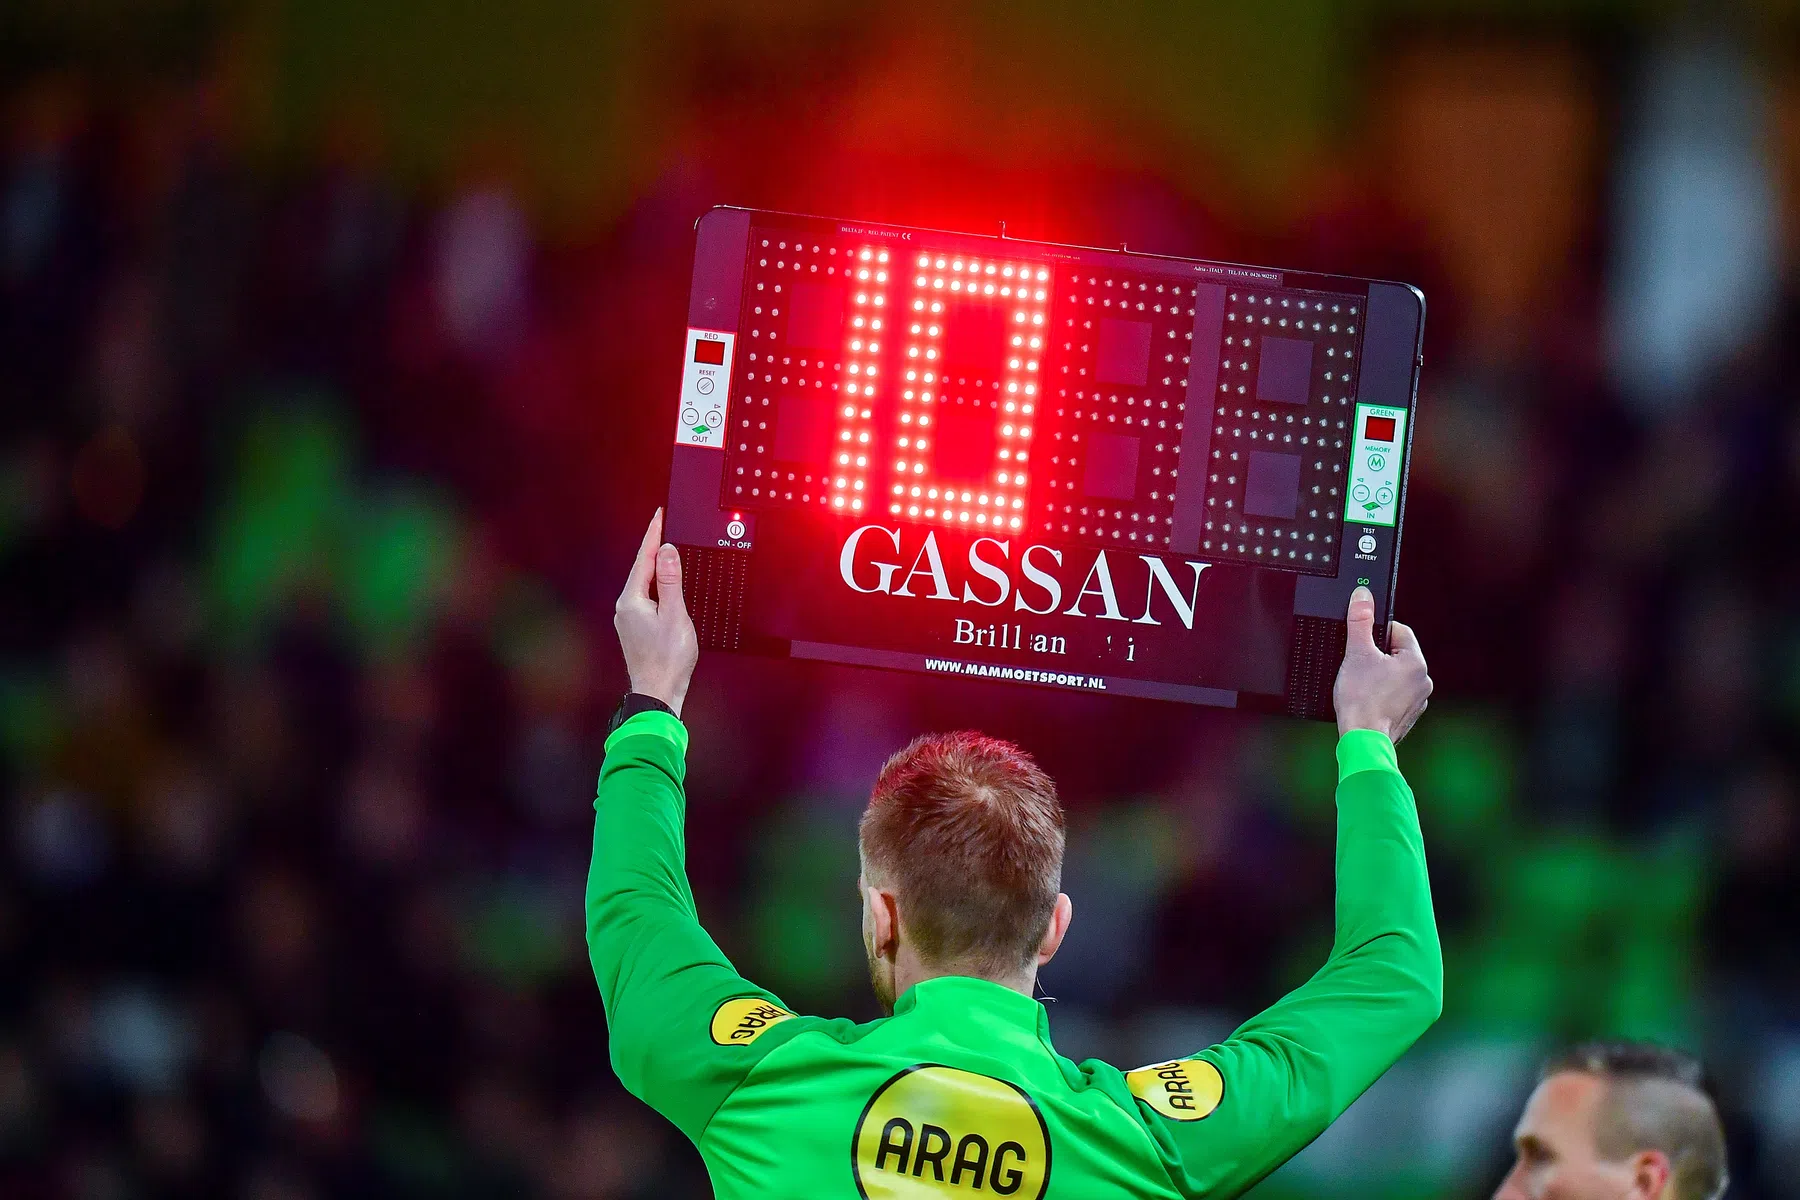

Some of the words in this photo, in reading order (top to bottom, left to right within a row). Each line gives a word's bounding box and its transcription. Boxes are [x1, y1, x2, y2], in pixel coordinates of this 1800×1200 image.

[704, 332, 719, 340] RED
[699, 369, 716, 377] RESET
[832, 247, 1049, 531] 10
[1369, 408, 1395, 417] GREEN
[691, 435, 708, 443] OUT
[1364, 445, 1392, 454] MEMORY
[1371, 457, 1382, 467] M
[717, 539, 730, 547] ON
[737, 541, 752, 549] OFF
[1354, 553, 1377, 561] BATTERY
[838, 523, 1212, 631] GASSAN
[1357, 577, 1370, 585] GO
[925, 658, 1107, 690] WWW.MAMMOETSPORT.NL
[874, 1116, 1026, 1196] ARAG
